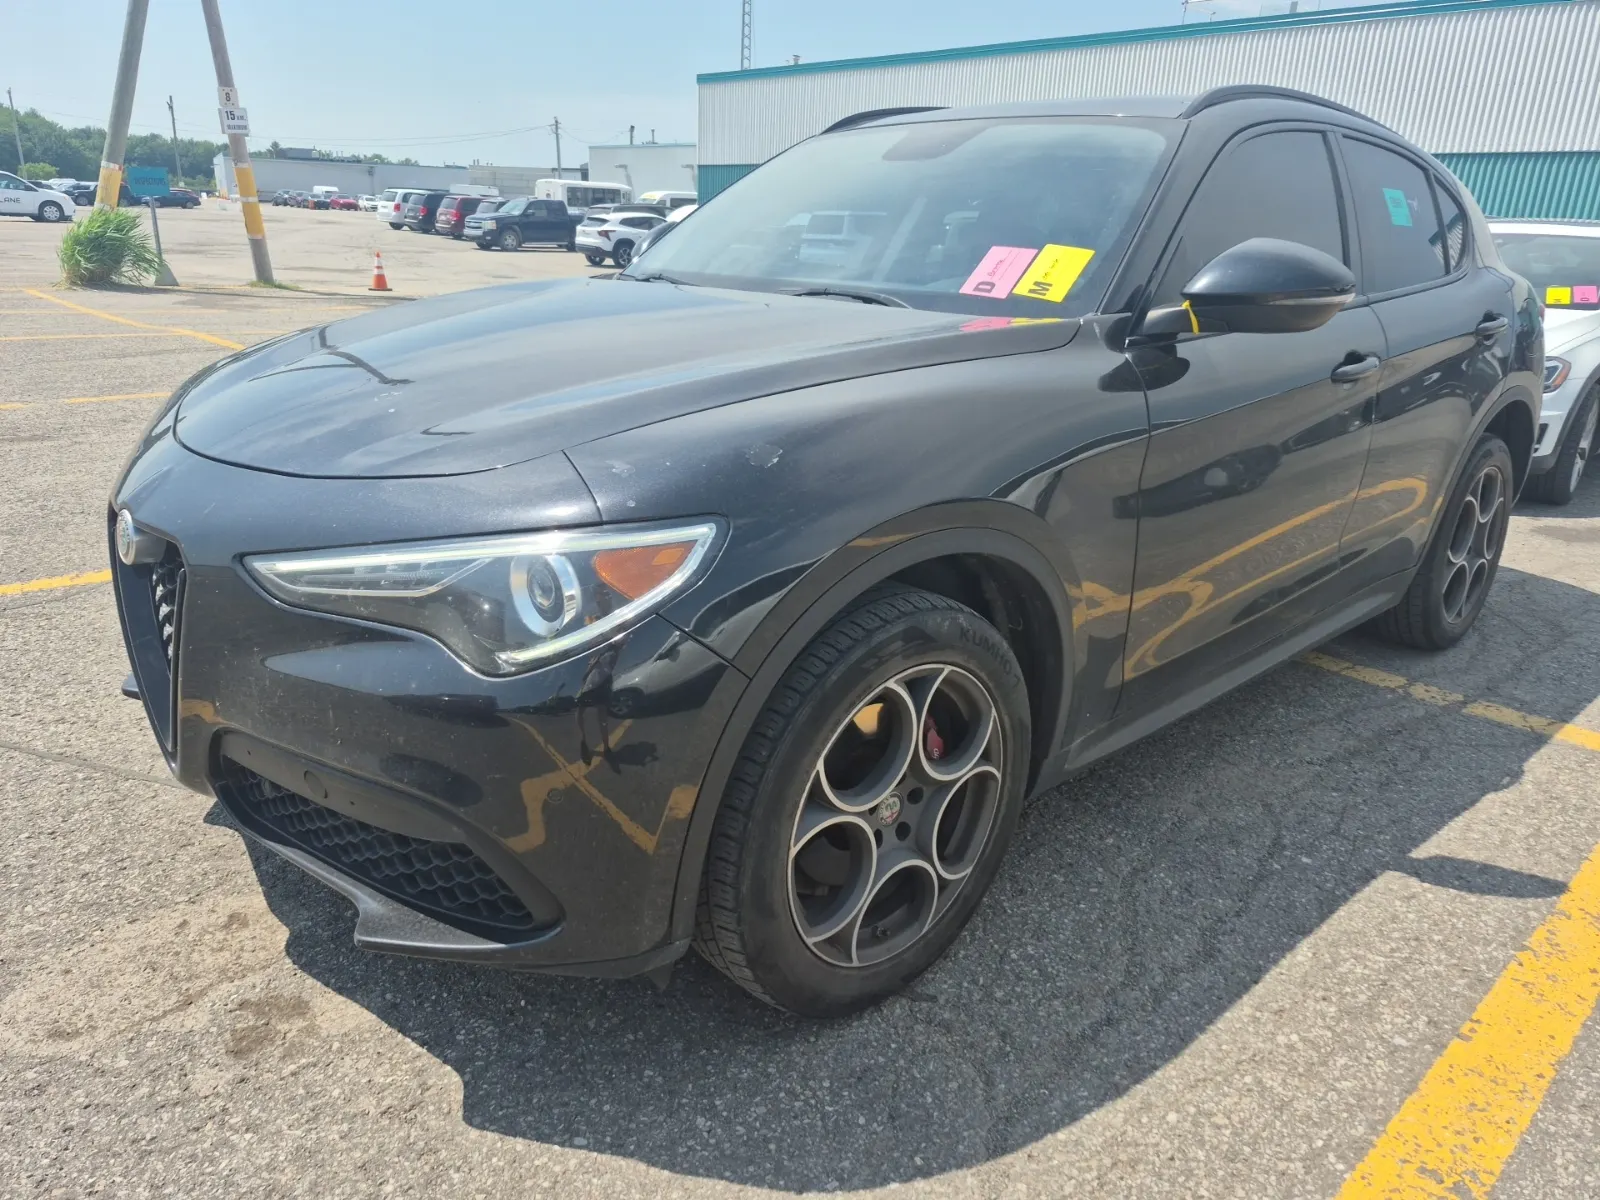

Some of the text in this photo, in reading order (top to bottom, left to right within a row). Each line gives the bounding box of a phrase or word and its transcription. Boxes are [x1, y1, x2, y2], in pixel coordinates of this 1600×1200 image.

[225, 92, 231, 102] 8
[225, 110, 236, 121] 15
[973, 281, 996, 294] D
[1027, 281, 1053, 297] M
[960, 627, 1012, 676] KUMHO
